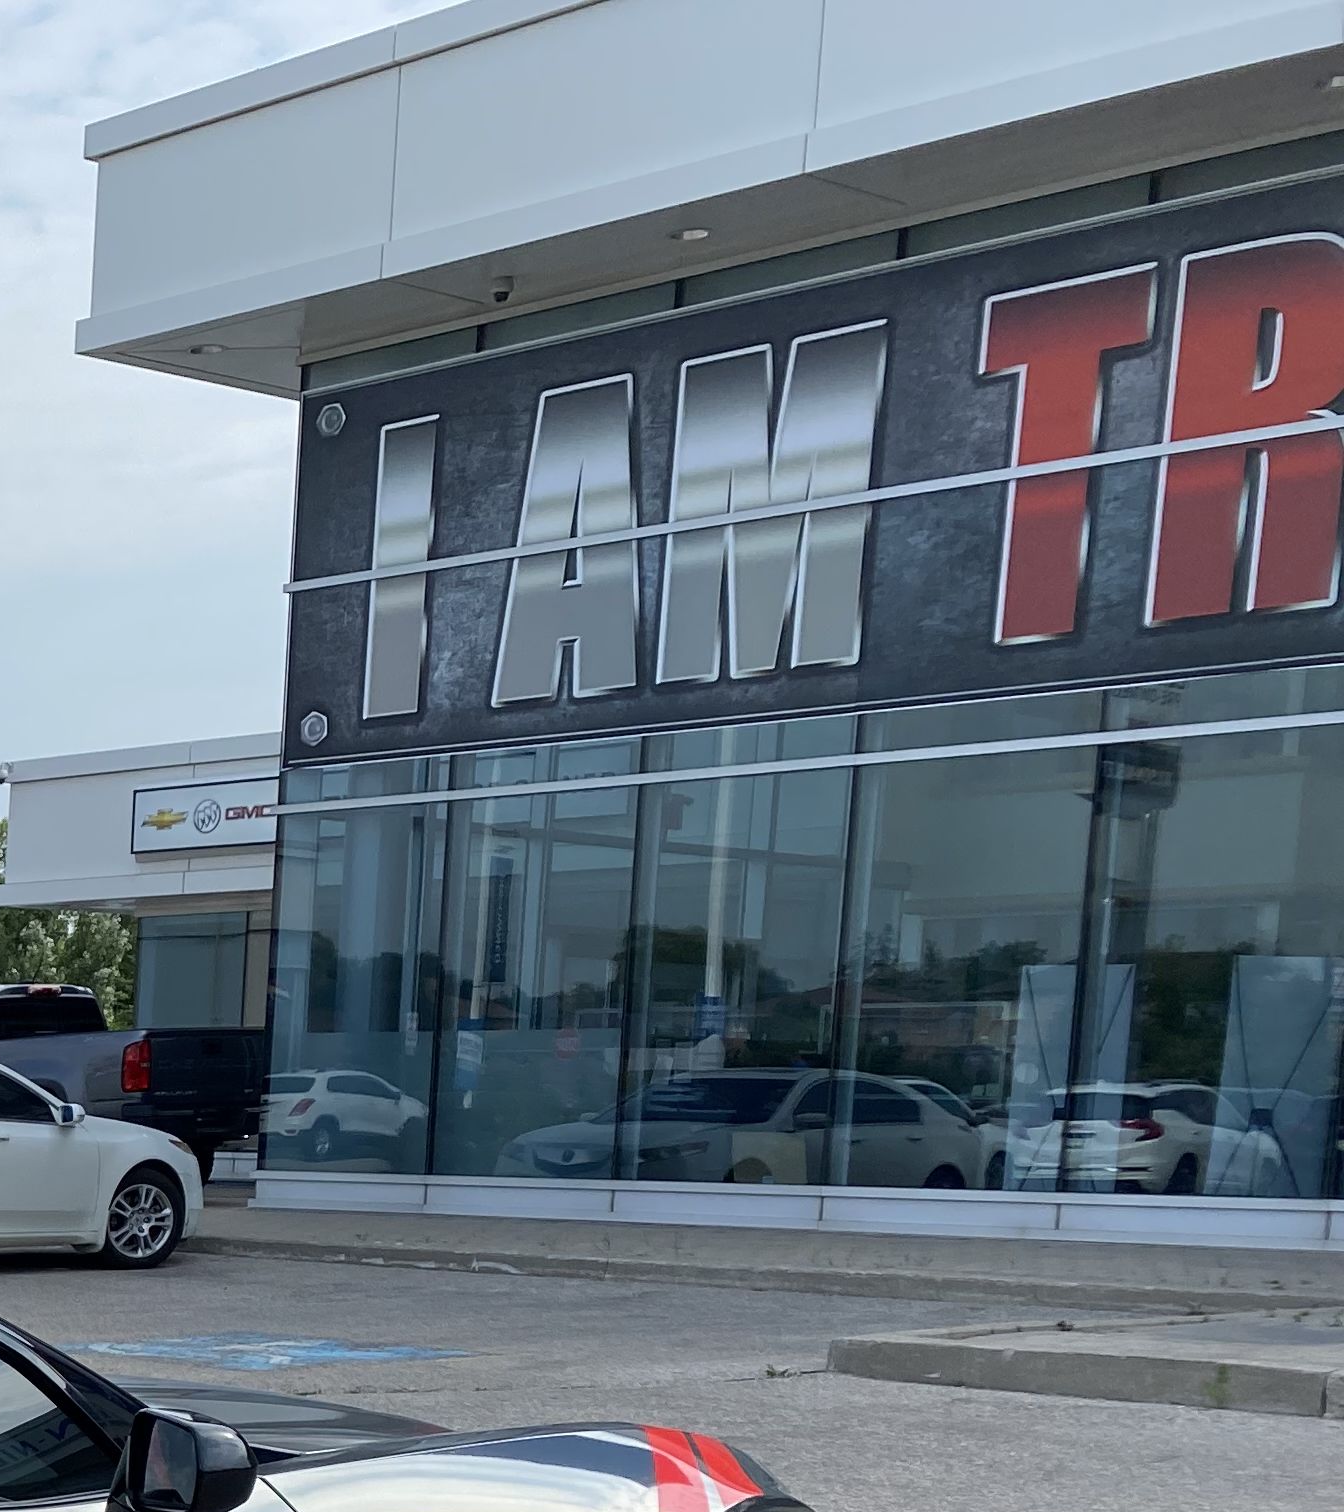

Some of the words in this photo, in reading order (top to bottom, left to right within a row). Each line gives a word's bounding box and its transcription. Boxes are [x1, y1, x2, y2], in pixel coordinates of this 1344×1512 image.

[362, 413, 440, 720] I
[490, 318, 889, 708] AM
[978, 231, 1344, 646] TR
[225, 804, 278, 821] GMC
